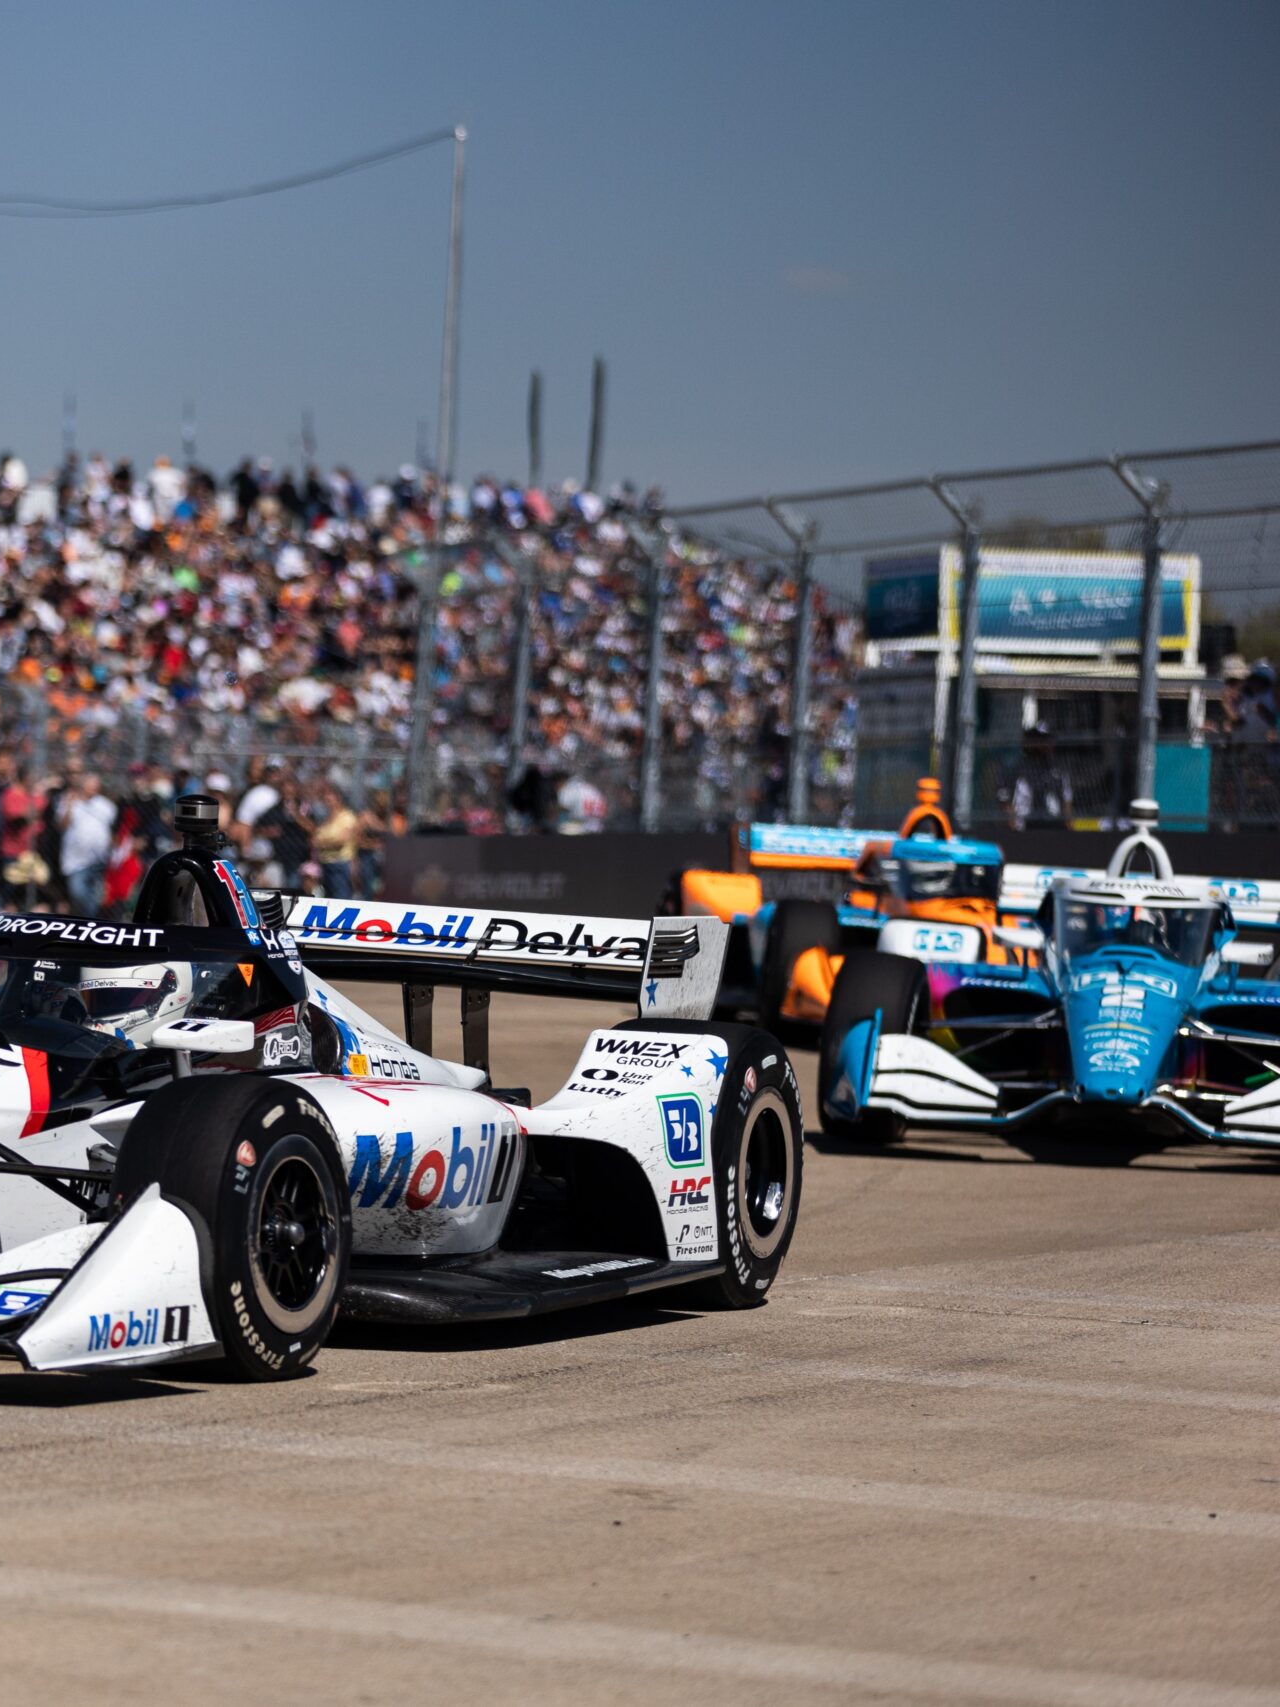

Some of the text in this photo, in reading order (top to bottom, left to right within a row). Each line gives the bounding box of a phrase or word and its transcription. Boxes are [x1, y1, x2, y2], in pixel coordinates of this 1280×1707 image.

[304, 905, 474, 948] Mobil
[94, 979, 118, 988] Delvac
[369, 1054, 421, 1081] Honda
[348, 1123, 495, 1211] Mobil
[689, 1205, 709, 1213] RACING
[727, 1166, 751, 1287] Firestone
[701, 1226, 713, 1238] NTT
[676, 1245, 713, 1258] Firestone
[88, 1308, 159, 1351] Mobil
[230, 1281, 286, 1371] Firestone
